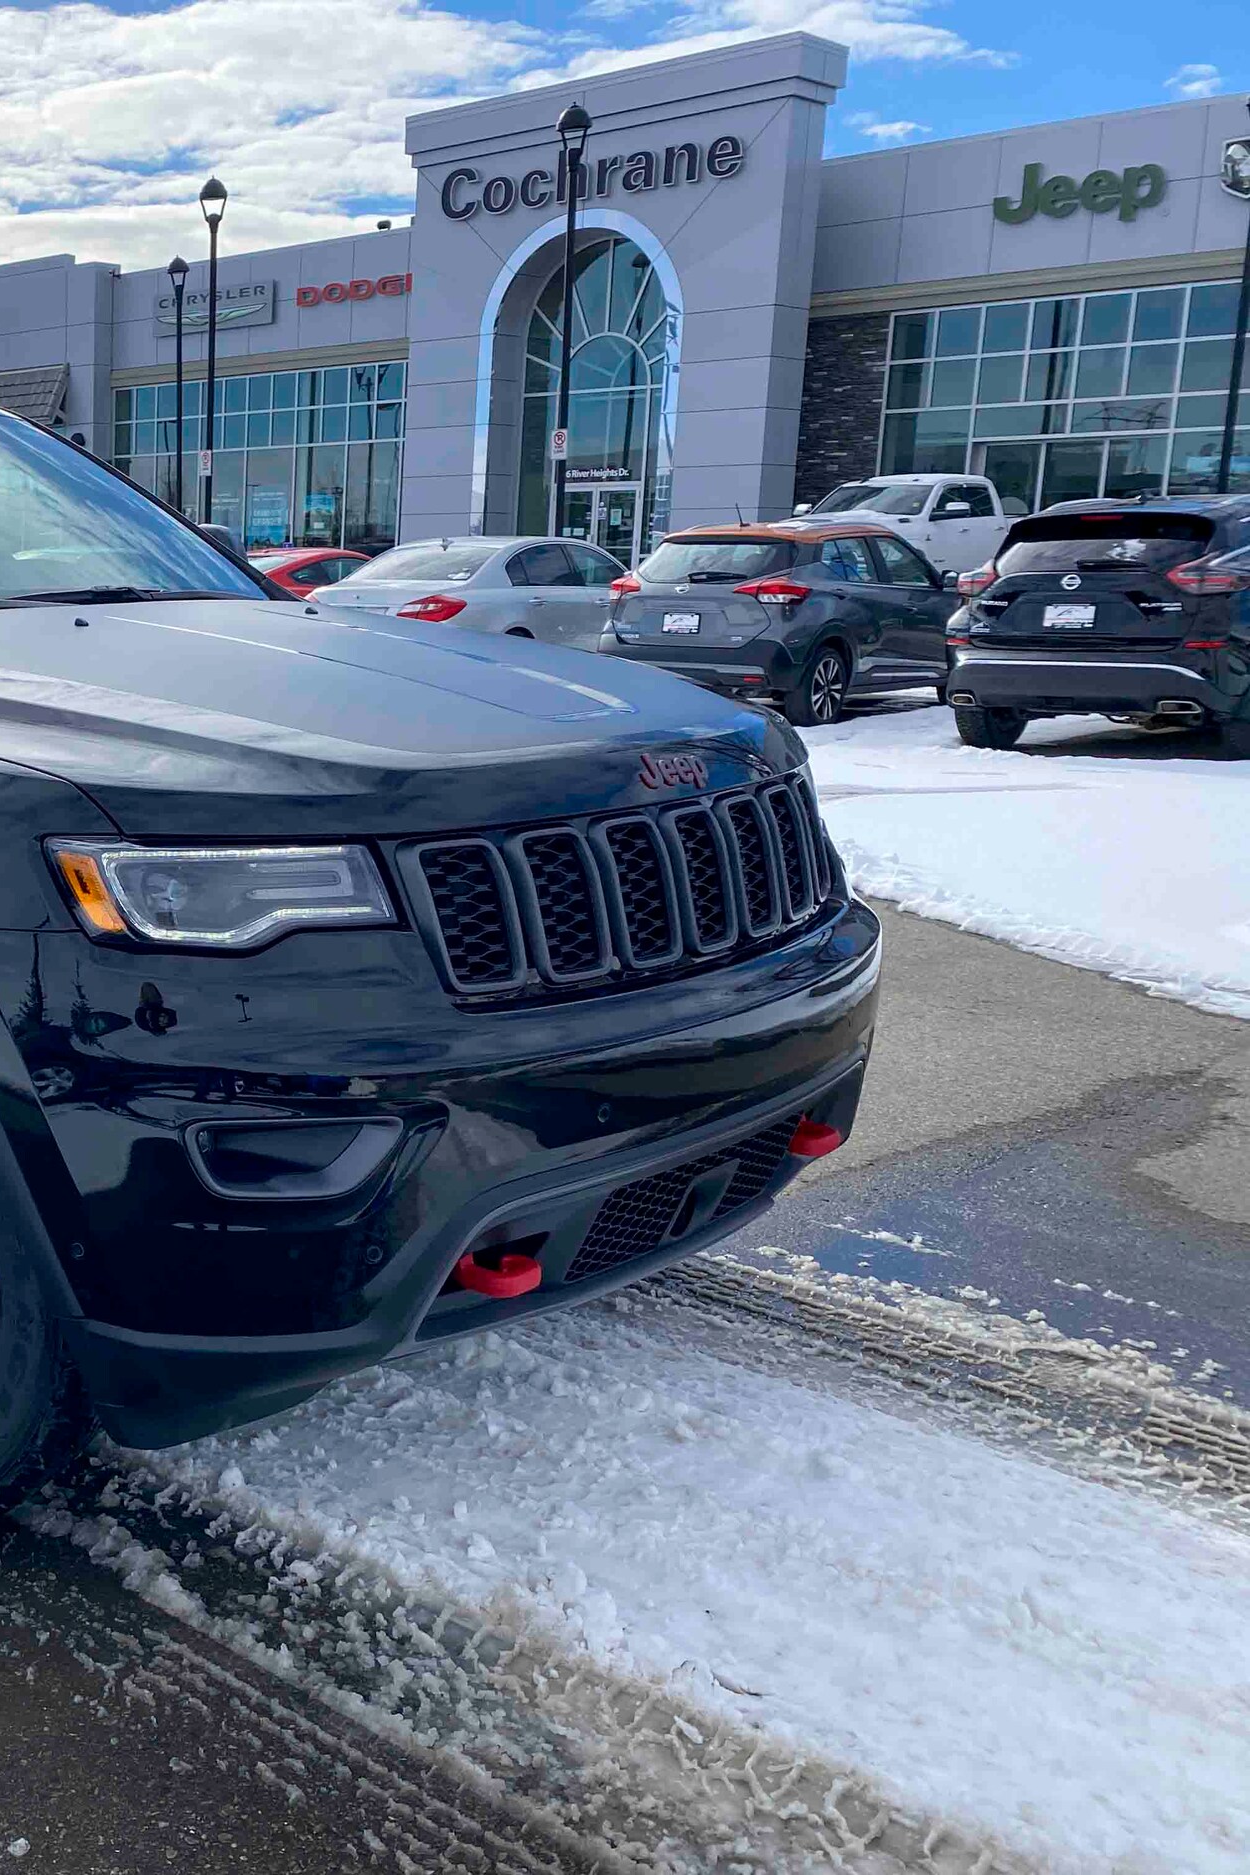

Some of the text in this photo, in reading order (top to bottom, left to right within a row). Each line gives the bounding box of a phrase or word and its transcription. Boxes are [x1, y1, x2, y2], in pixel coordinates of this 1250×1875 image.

[441, 134, 745, 221] Cochrane
[993, 161, 1167, 225] Jeep
[572, 469, 589, 478] River
[590, 467, 618, 479] Heights
[638, 752, 709, 790] Jeep
